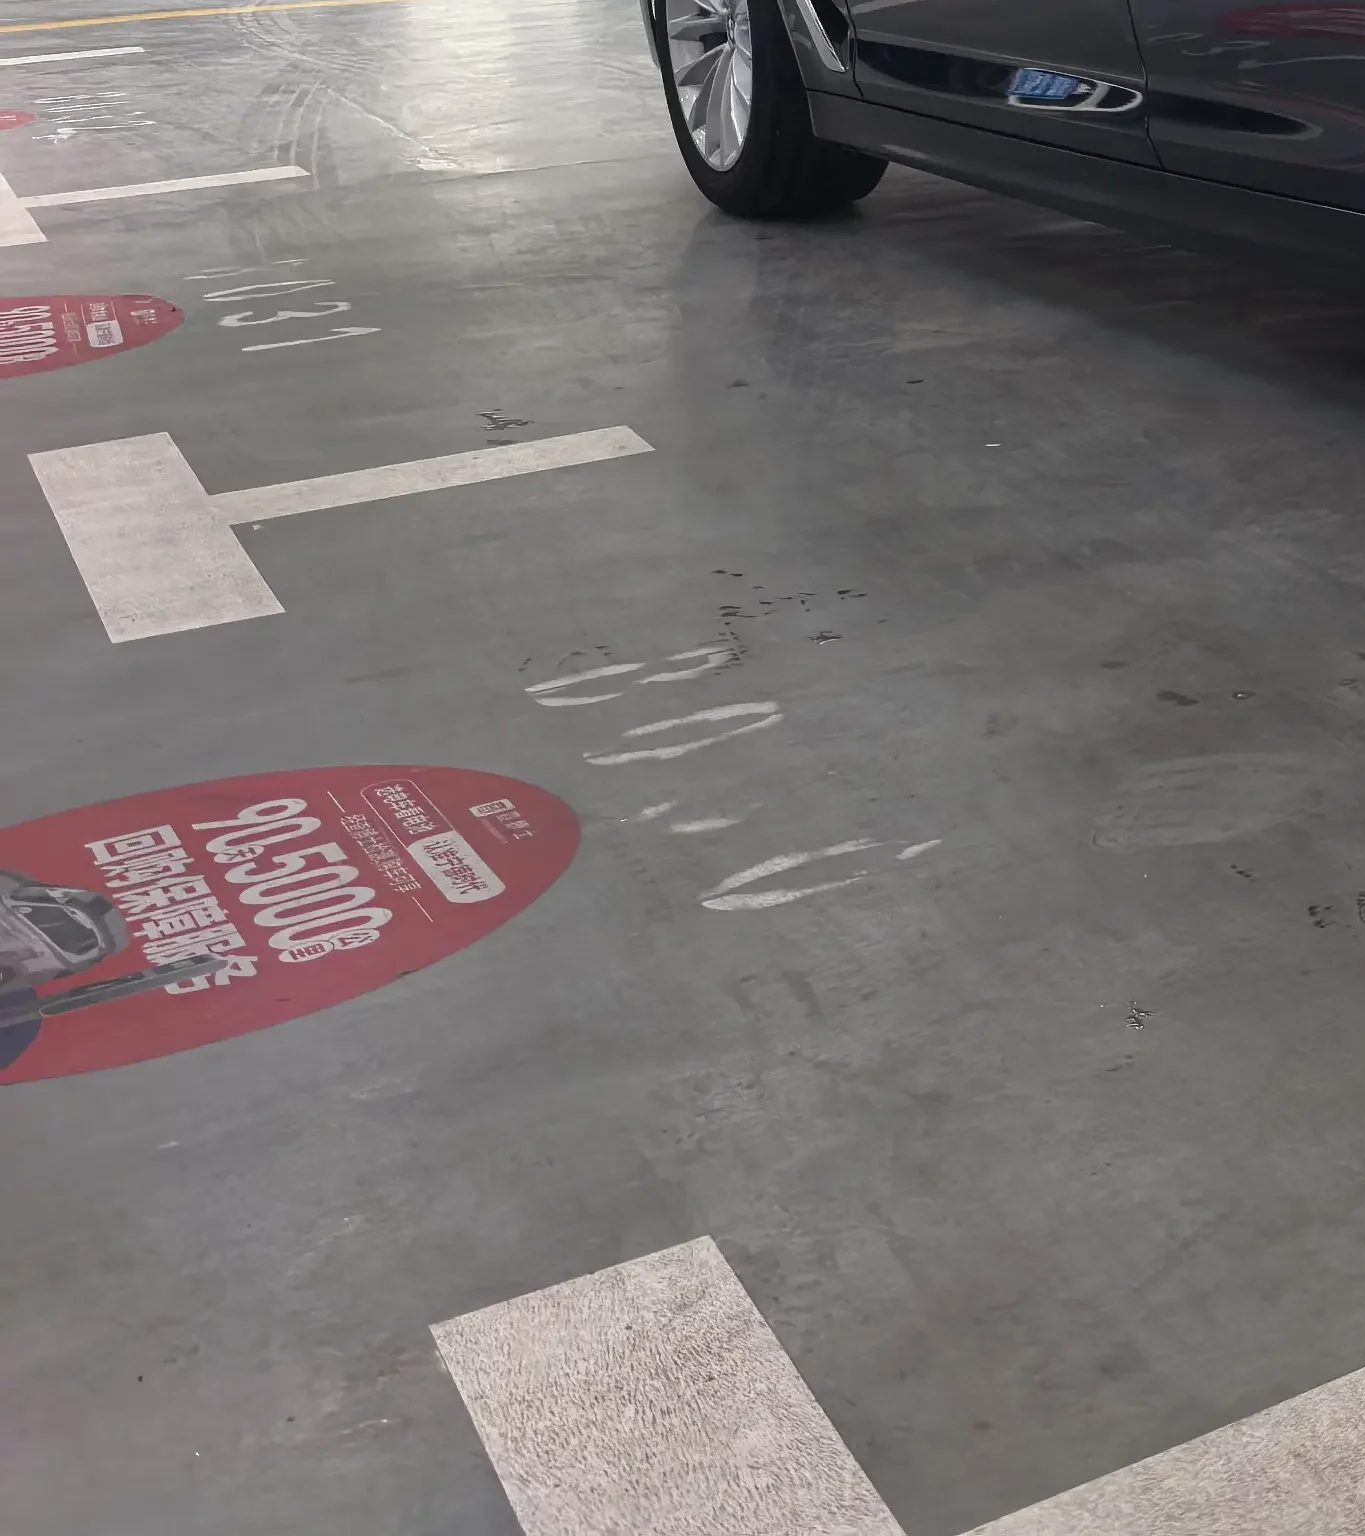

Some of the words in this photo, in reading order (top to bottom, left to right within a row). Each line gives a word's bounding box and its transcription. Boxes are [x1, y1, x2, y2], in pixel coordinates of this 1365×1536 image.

[84, 824, 258, 995] 回购保障服务
